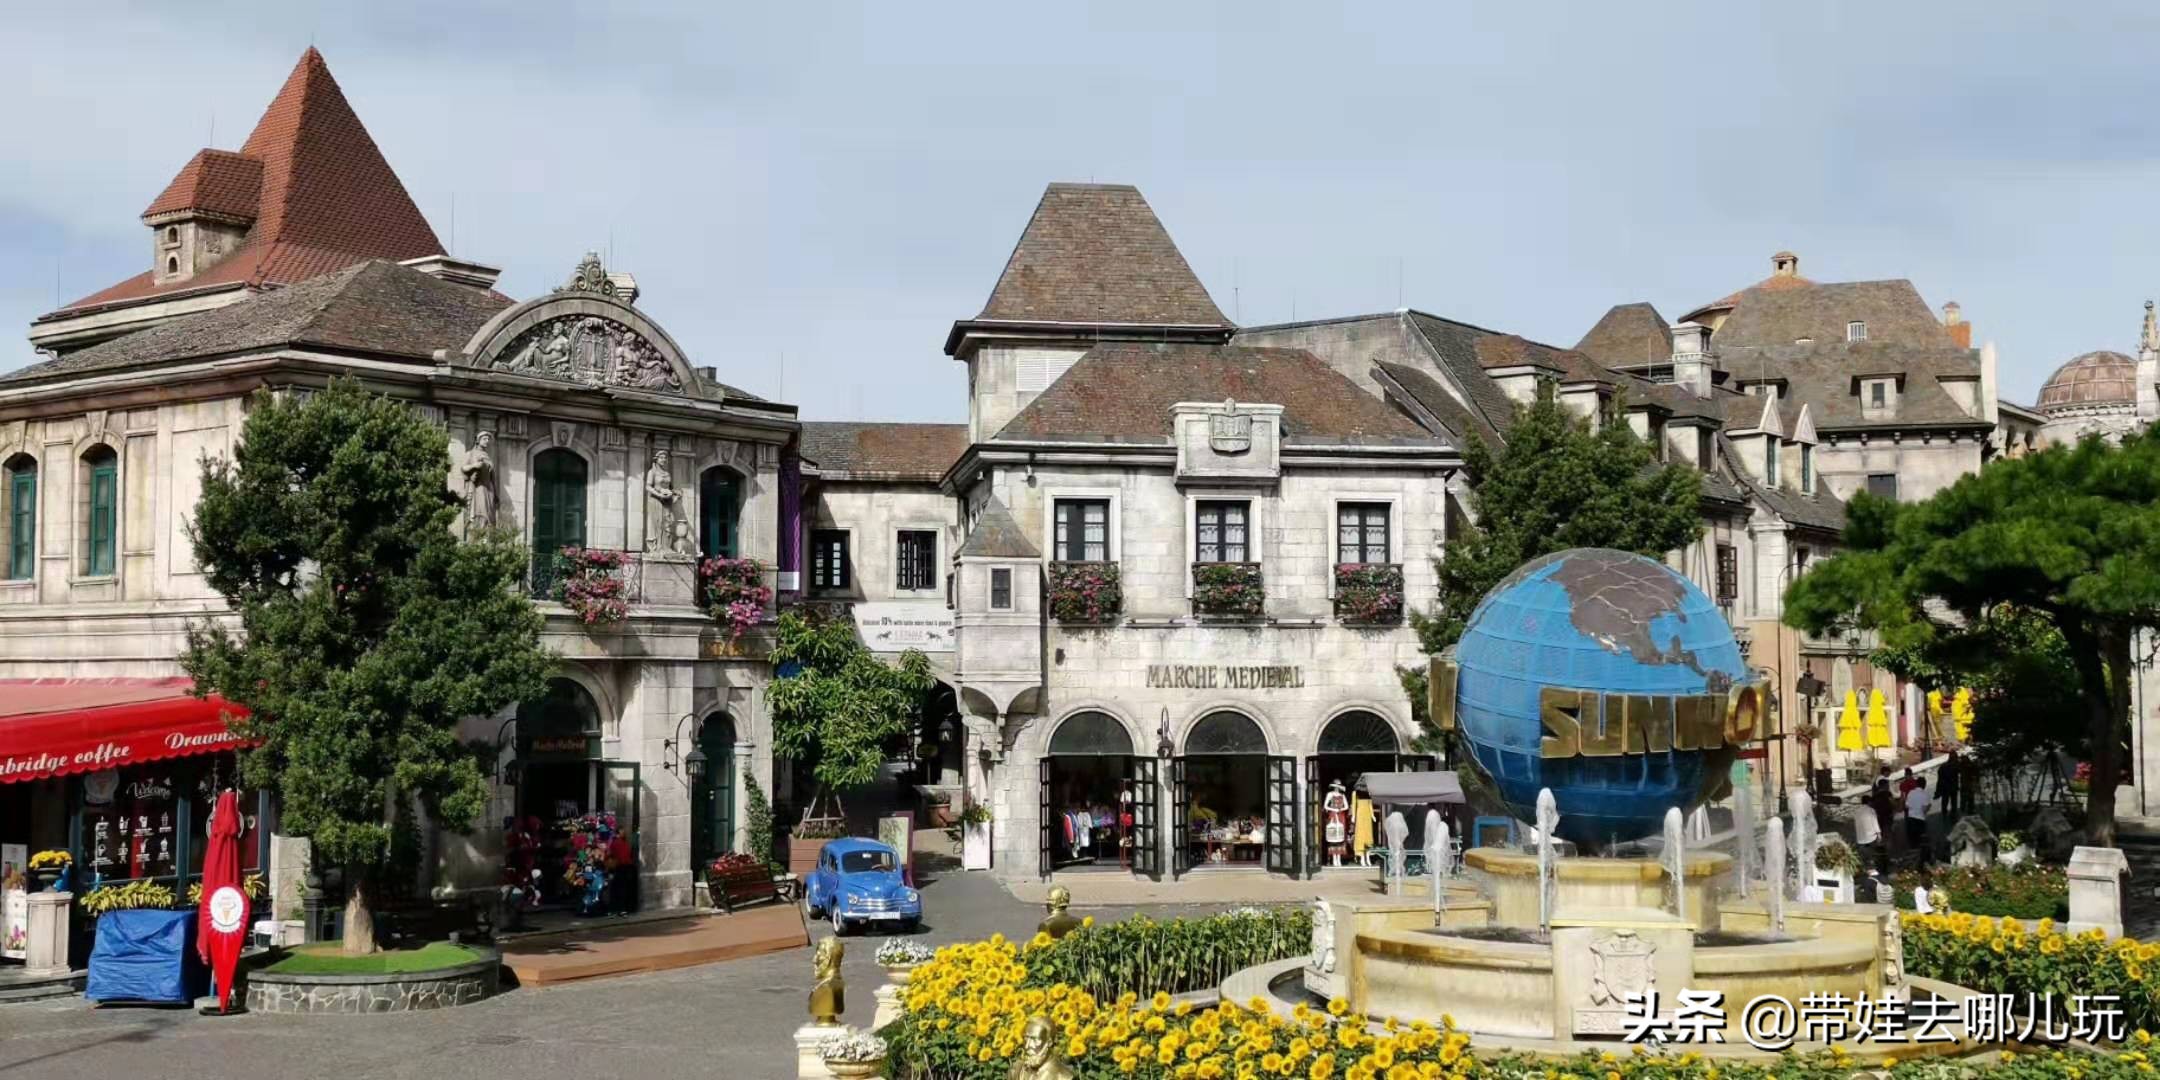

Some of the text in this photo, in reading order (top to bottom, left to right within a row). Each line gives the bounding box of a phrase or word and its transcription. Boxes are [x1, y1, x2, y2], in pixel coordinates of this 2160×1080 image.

[1146, 665, 1304, 689] MARCHE MEDIEVAL
[74, 742, 130, 764] coffee
